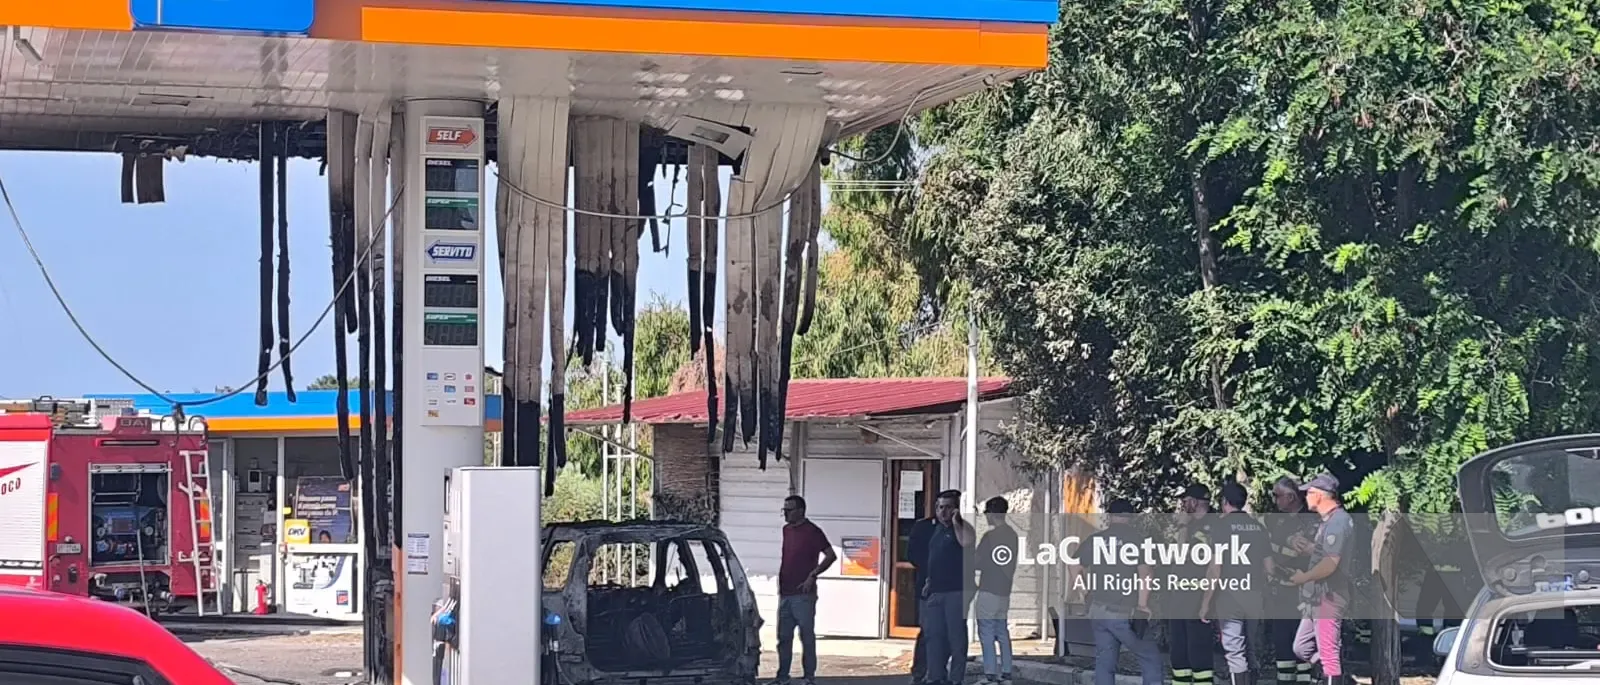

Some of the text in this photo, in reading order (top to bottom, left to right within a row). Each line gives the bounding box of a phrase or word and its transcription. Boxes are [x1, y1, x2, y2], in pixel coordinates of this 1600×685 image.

[436, 130, 462, 141] SELF
[432, 245, 473, 258] SERVITO
[288, 528, 306, 536] DKV
[1231, 523, 1261, 532] POLIZIA
